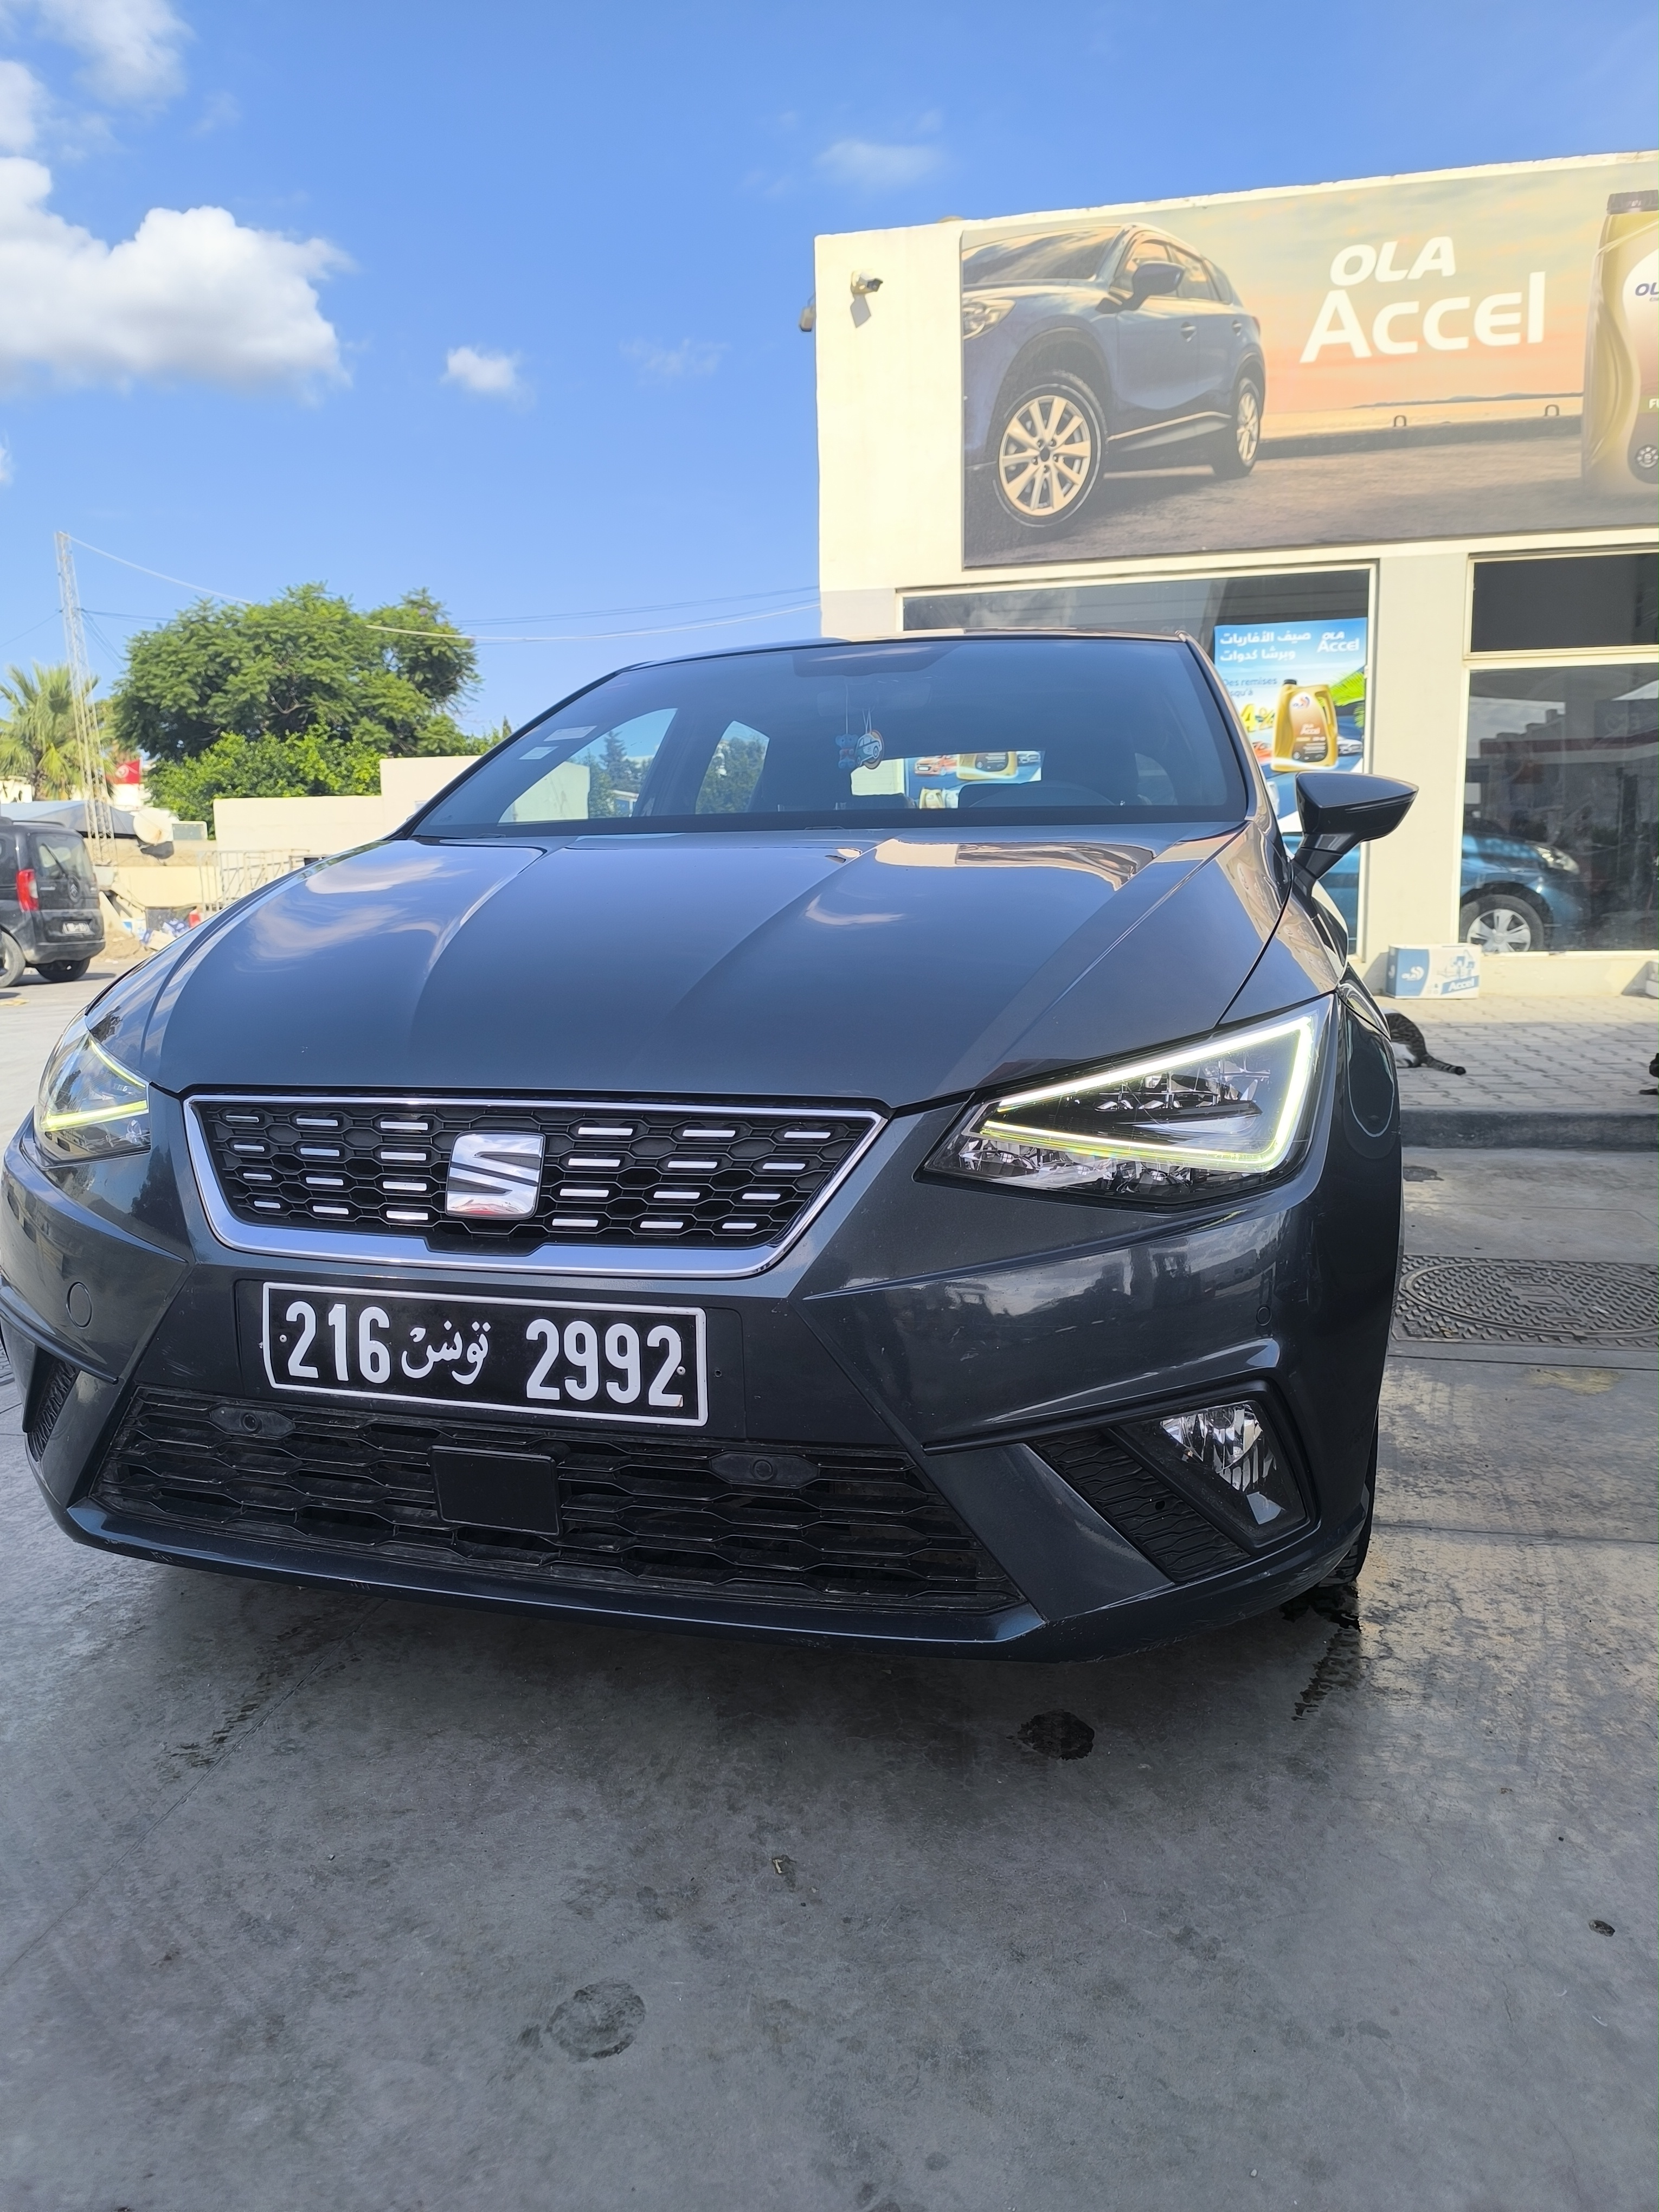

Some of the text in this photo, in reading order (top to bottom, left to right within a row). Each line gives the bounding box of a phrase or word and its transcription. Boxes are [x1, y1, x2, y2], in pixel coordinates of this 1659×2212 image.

[1329, 236, 1456, 286] OLA
[1300, 271, 1546, 363] Accel
[1277, 630, 1311, 644] صيف
[1317, 637, 1360, 653] Accel
[1240, 677, 1278, 686] remises
[285, 1300, 684, 1407] 216 تونس 2992
